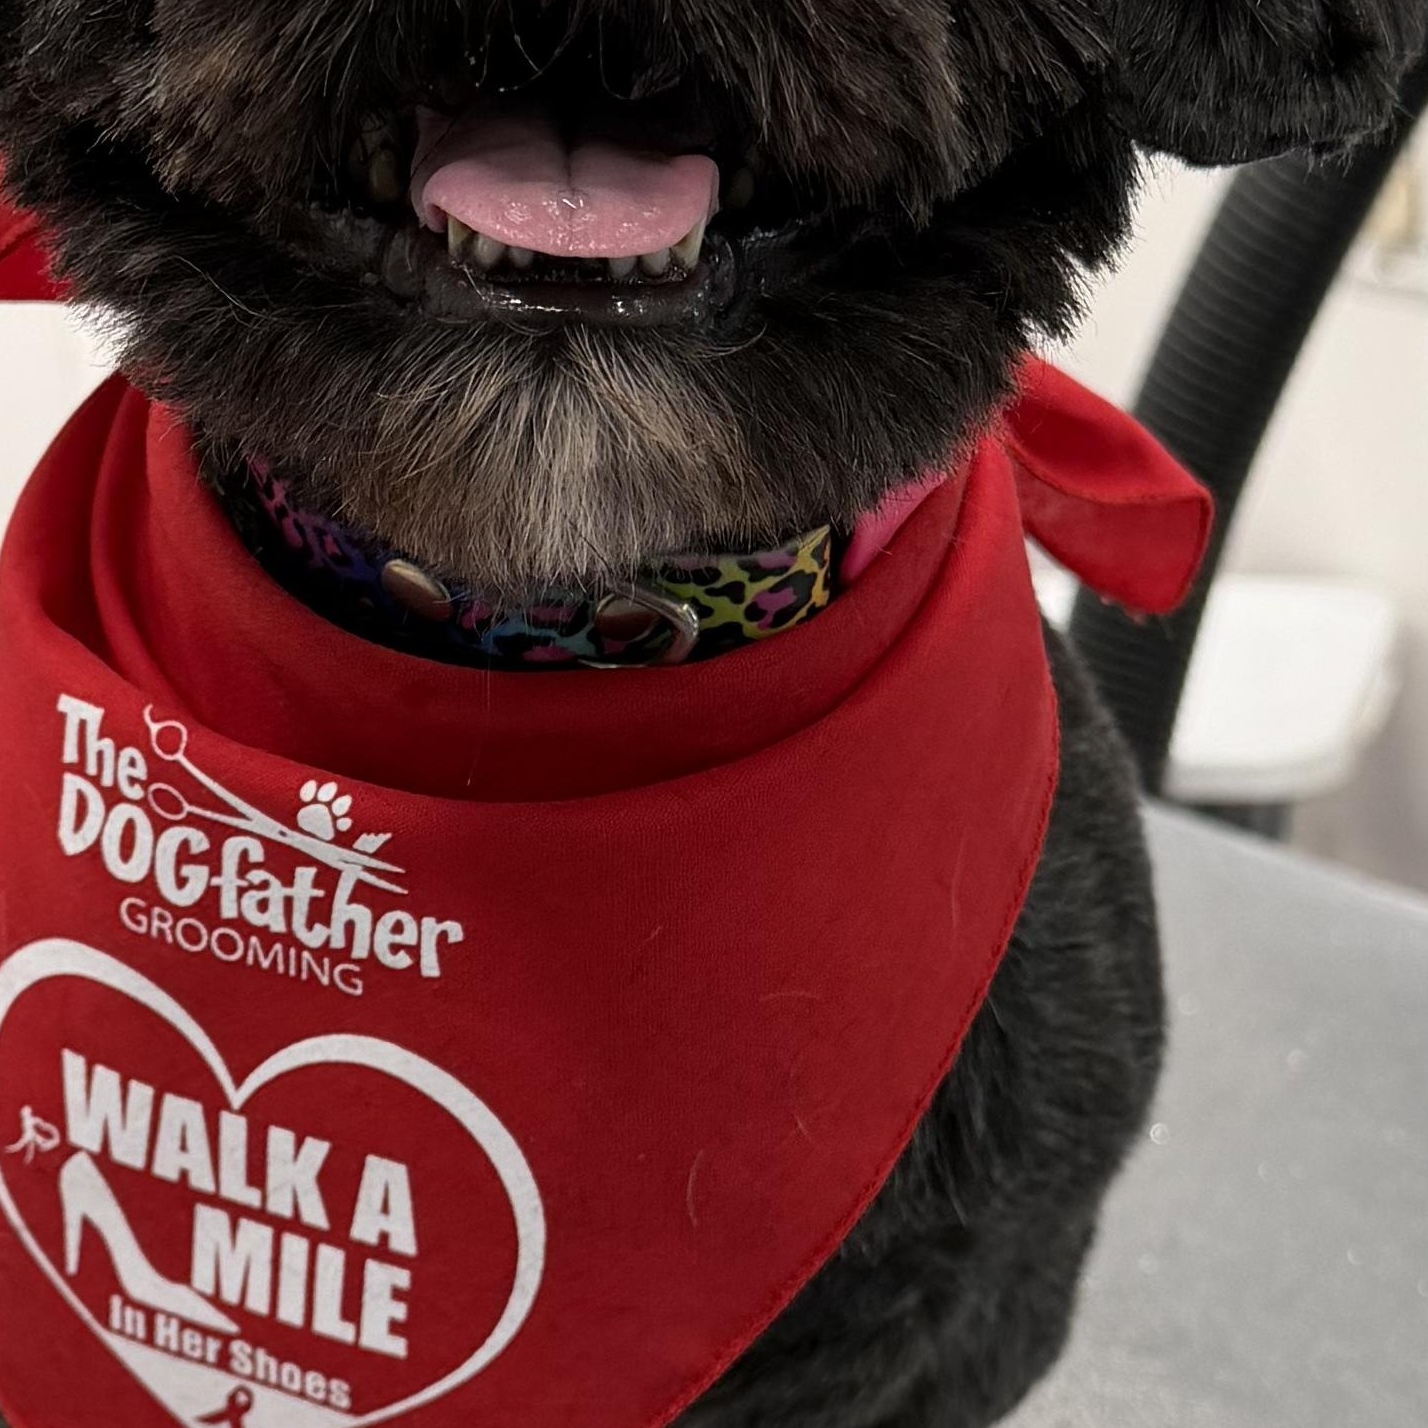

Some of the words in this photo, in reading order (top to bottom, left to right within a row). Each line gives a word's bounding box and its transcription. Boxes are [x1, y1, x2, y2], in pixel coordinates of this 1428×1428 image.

[57, 693, 147, 800] The
[58, 771, 464, 977] DOGfather
[119, 897, 364, 996] GROOMING
[60, 1047, 332, 1232] WALK
[348, 1153, 418, 1257] A
[190, 1202, 411, 1360] MILE
[108, 1294, 147, 1340] In
[153, 1317, 223, 1366] Her
[227, 1337, 353, 1410] Shoes
